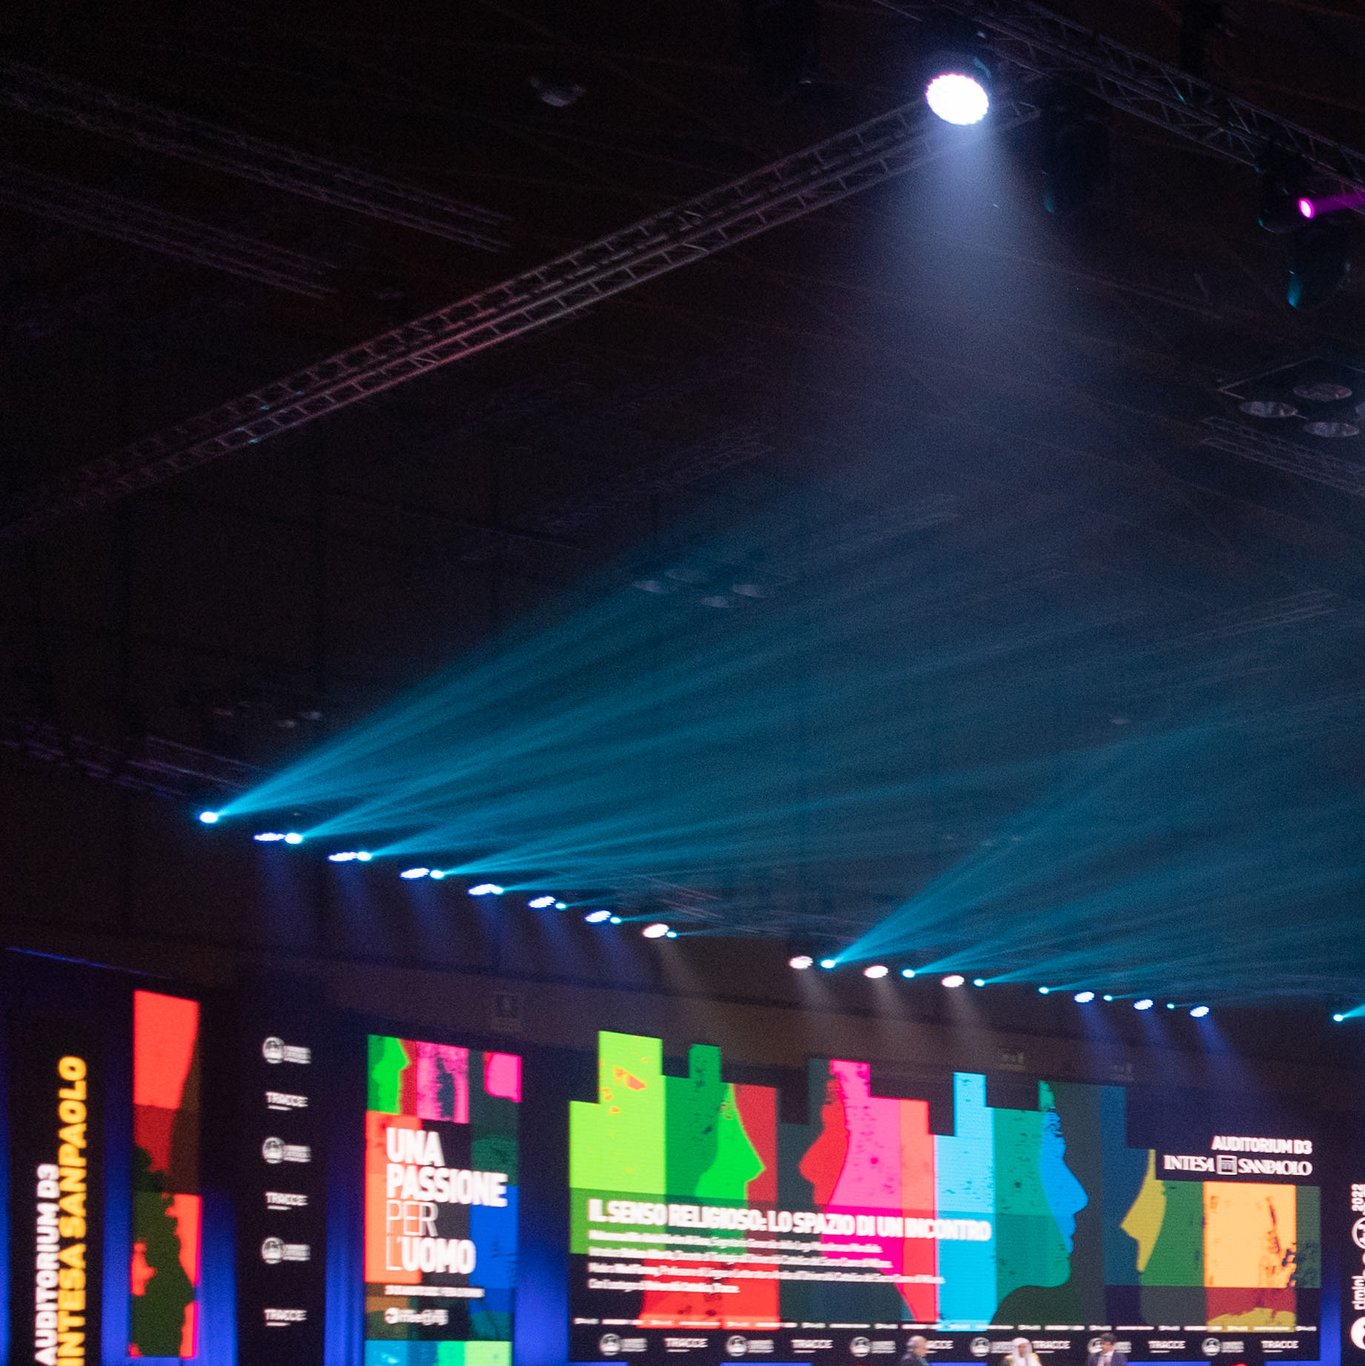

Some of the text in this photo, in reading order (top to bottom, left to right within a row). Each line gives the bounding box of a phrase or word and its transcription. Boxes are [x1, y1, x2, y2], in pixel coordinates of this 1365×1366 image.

[57, 1056, 88, 1239] SANPAOLO
[386, 1127, 445, 1166] UNA
[1211, 1135, 1313, 1155] AUDITORIUM D3
[1163, 1155, 1313, 1176] INTESA SANPAOLO
[386, 1163, 509, 1208] PASSIONE
[1351, 1183, 1364, 1212] 2022
[386, 1199, 439, 1237] PER
[589, 1199, 991, 1241] IL SENSO RELIGIOSO: LO SPAZIO DI UN INCONTRO
[34, 1163, 60, 1366] AUDITORIUM D3
[386, 1235, 476, 1274] L'UOMO
[1352, 1275, 1364, 1311] rimini
[665, 1337, 709, 1348] TRACCE
[1148, 1340, 1186, 1349] TRACCE
[1261, 1340, 1299, 1349] TRACCE
